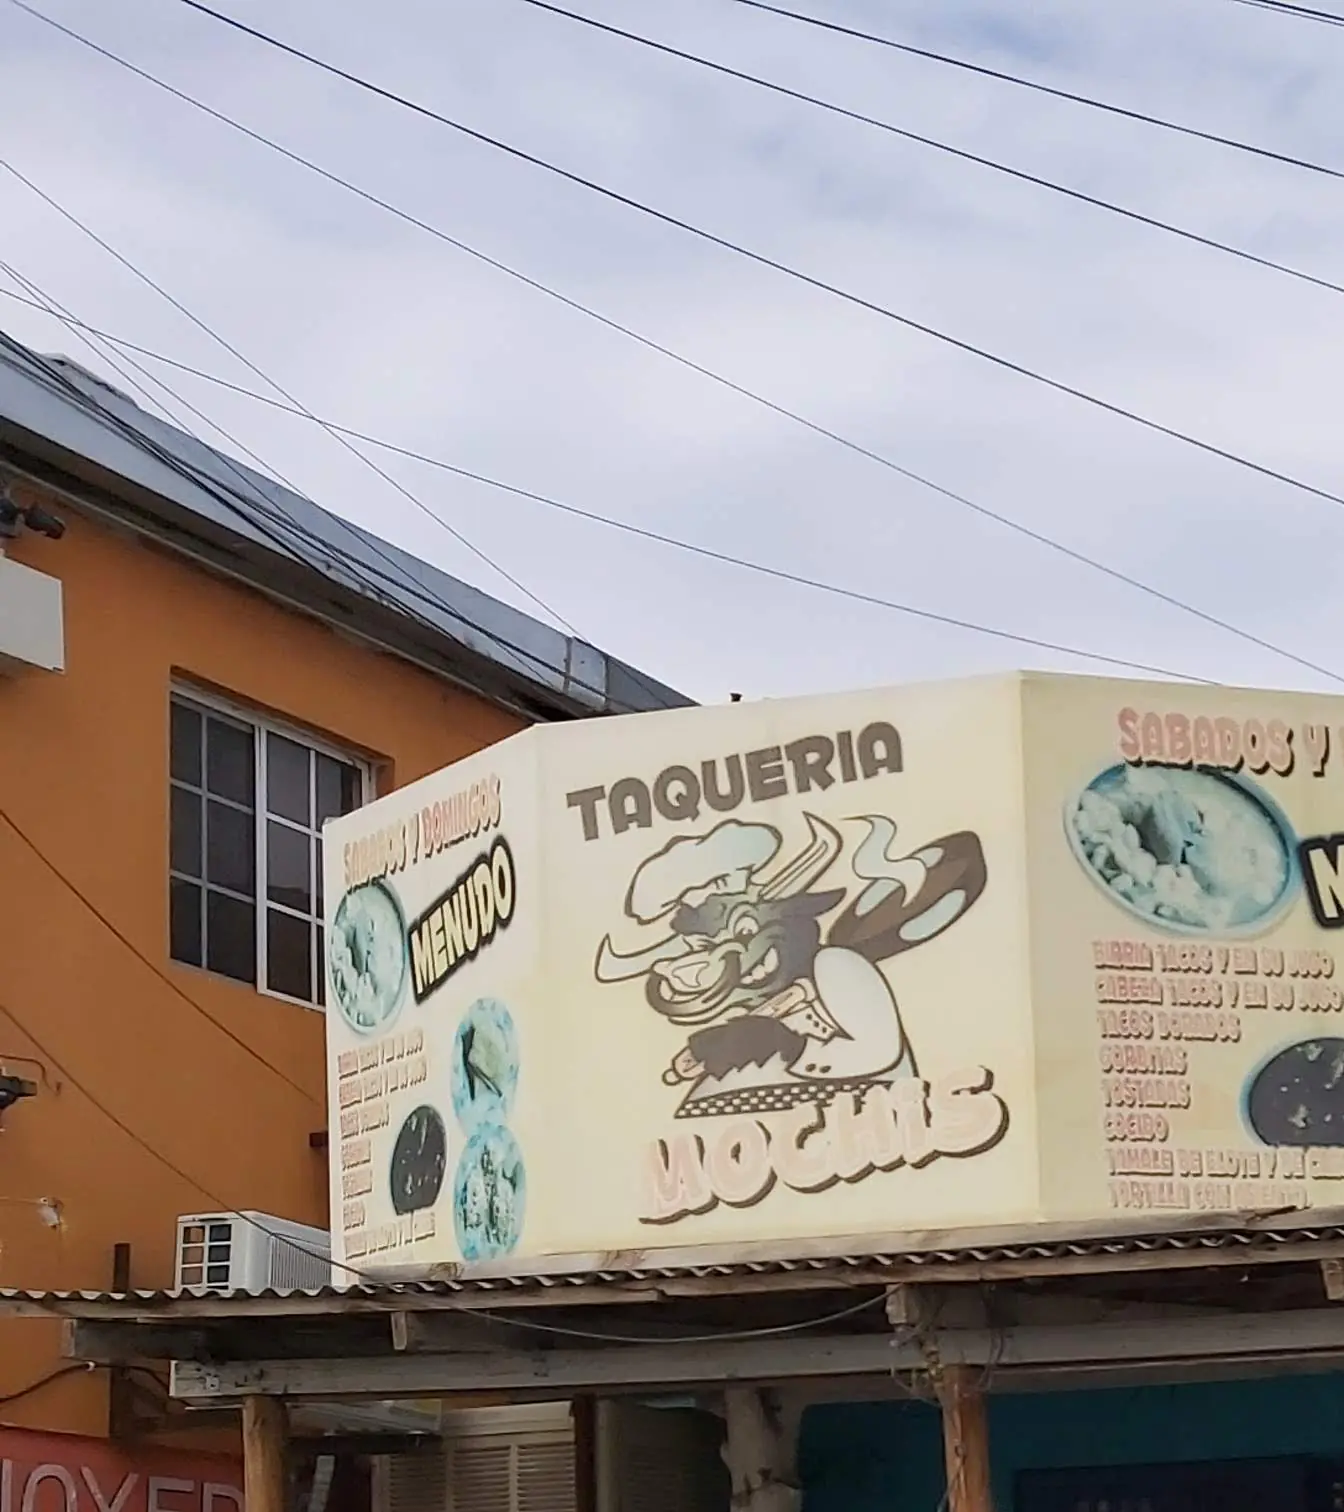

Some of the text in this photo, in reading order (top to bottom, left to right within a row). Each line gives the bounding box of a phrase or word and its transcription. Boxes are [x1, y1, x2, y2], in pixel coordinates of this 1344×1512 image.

[566, 720, 904, 842] TAQUERIA
[1118, 706, 1294, 778] SABADOS
[1304, 727, 1331, 777] Y
[411, 840, 514, 1000] MENUDO
